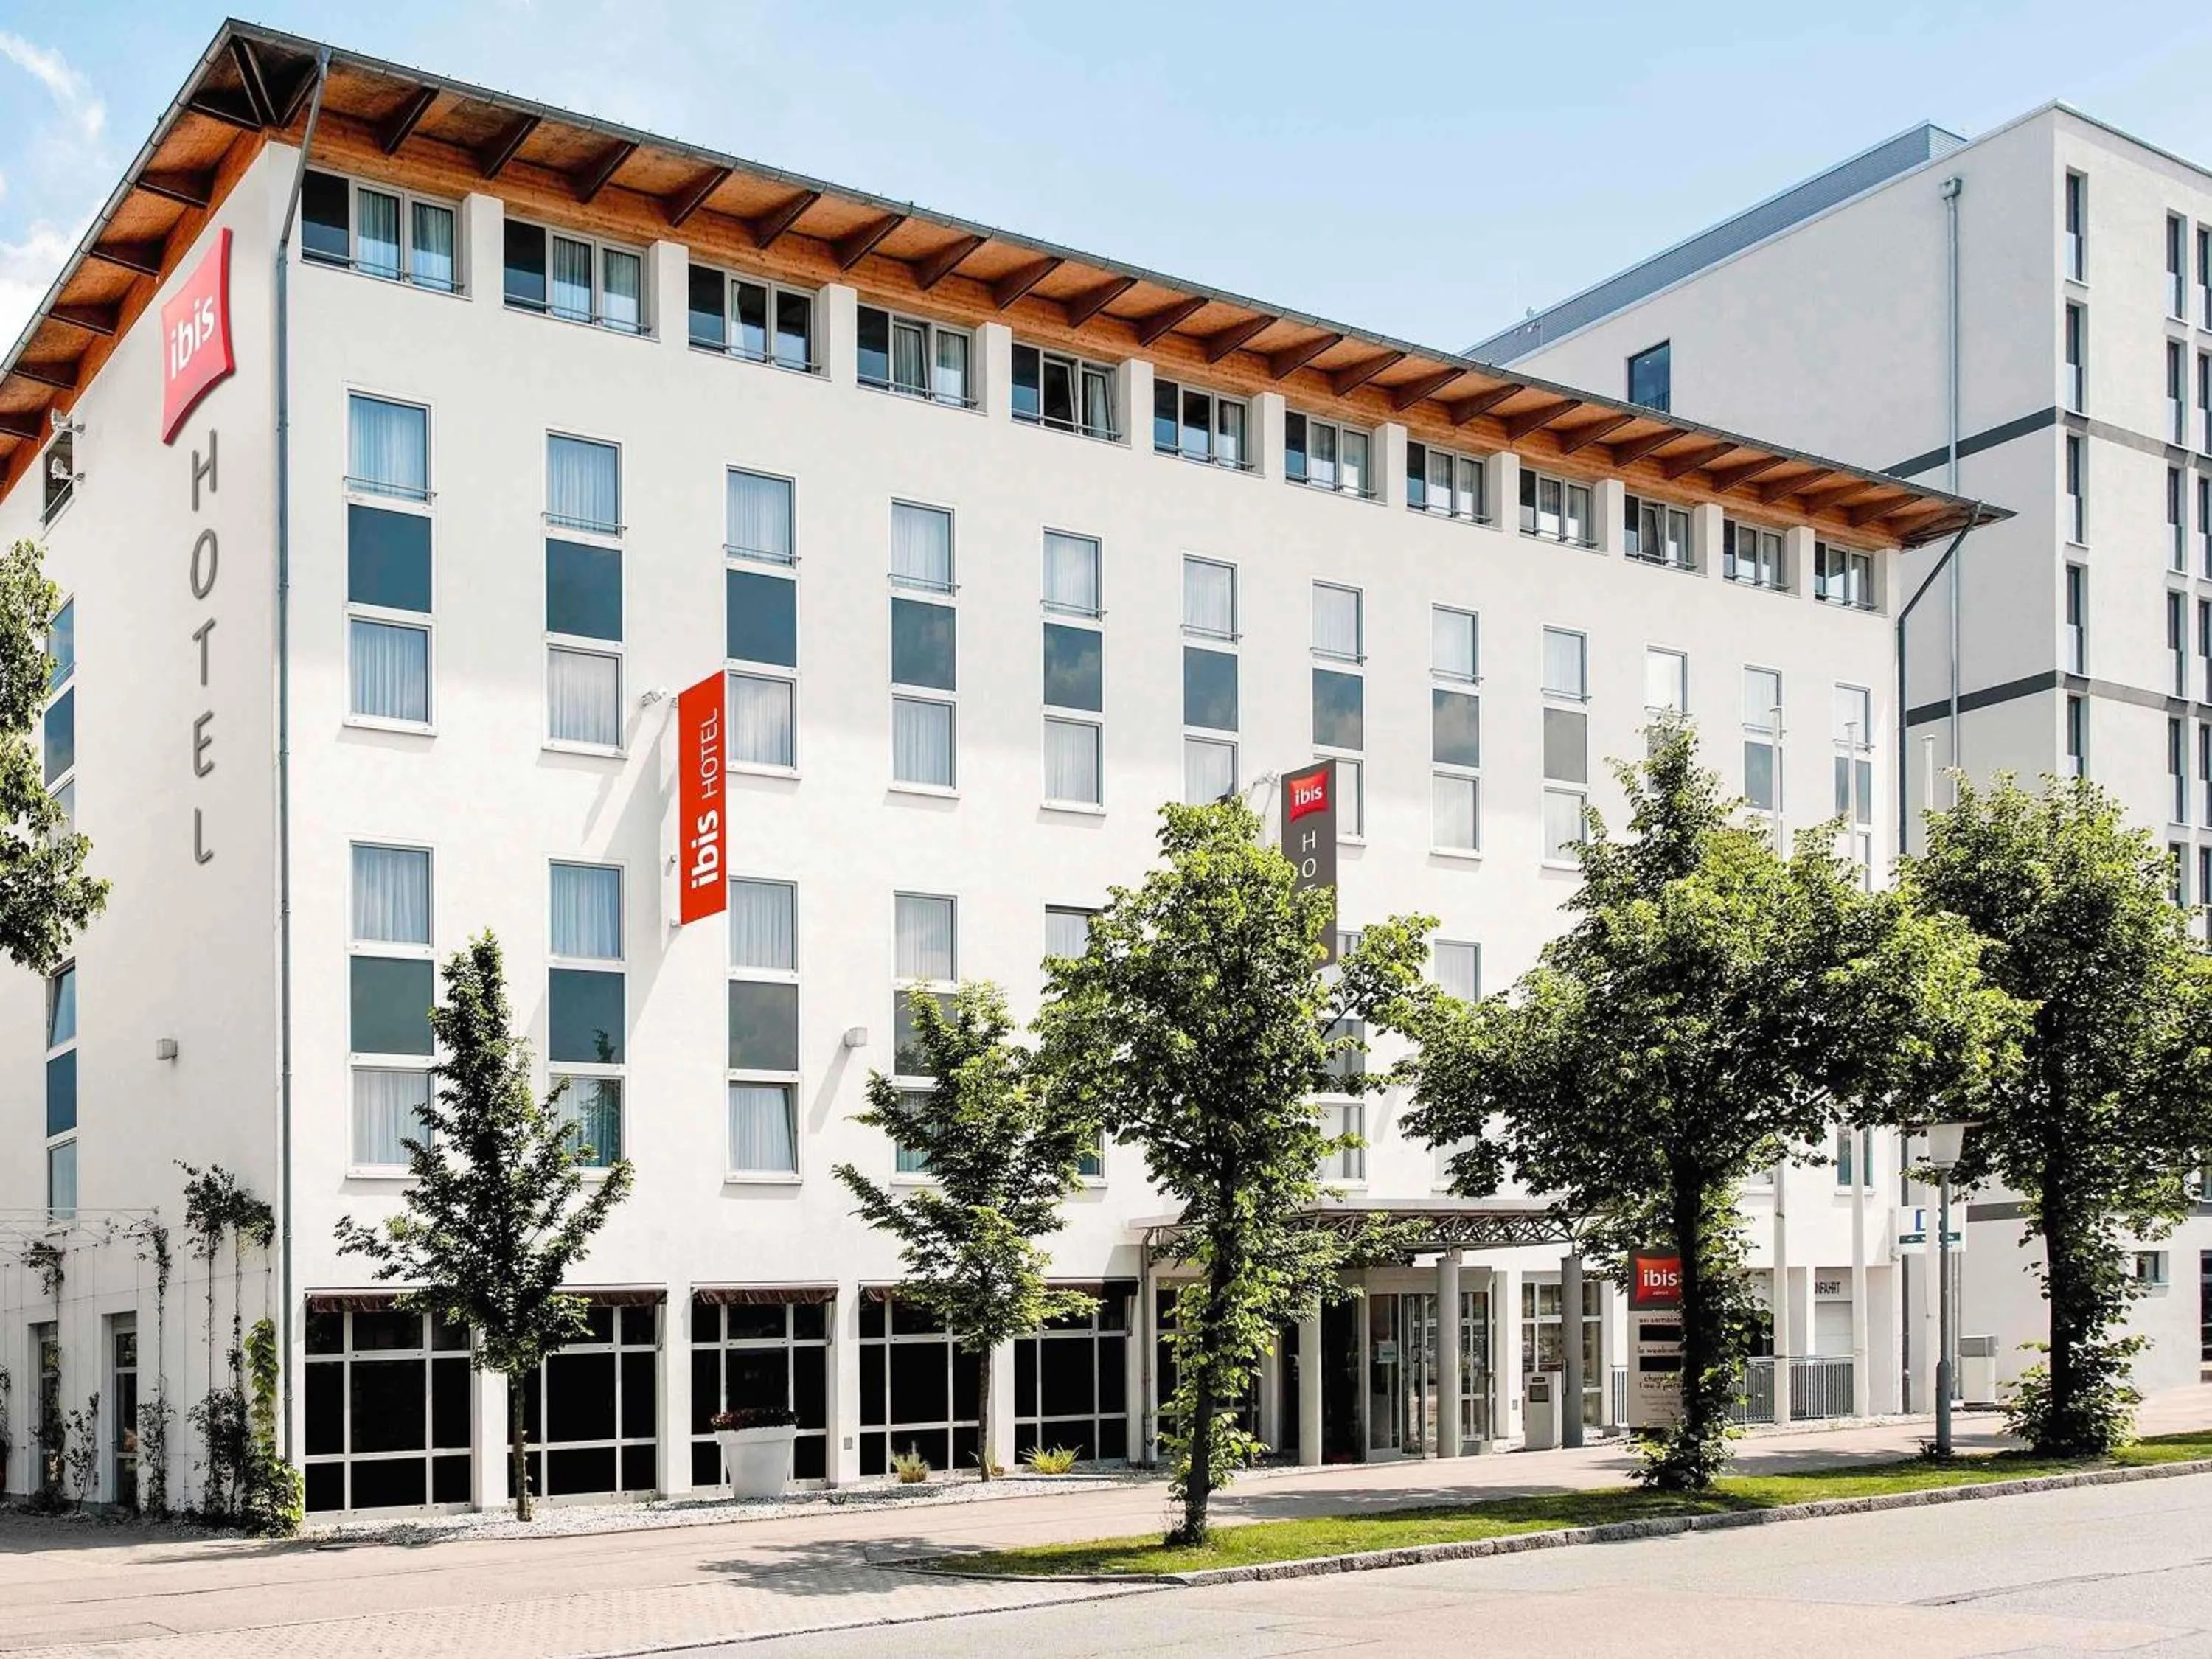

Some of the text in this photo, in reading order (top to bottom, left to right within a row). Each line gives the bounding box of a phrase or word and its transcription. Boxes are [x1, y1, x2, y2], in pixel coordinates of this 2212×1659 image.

[170, 296, 215, 380] ibis
[190, 428, 217, 865] HOTEL
[691, 708, 719, 888] ibis HOTEL
[1295, 786, 1322, 806] ibis
[1644, 1269, 1677, 1287] ibis
